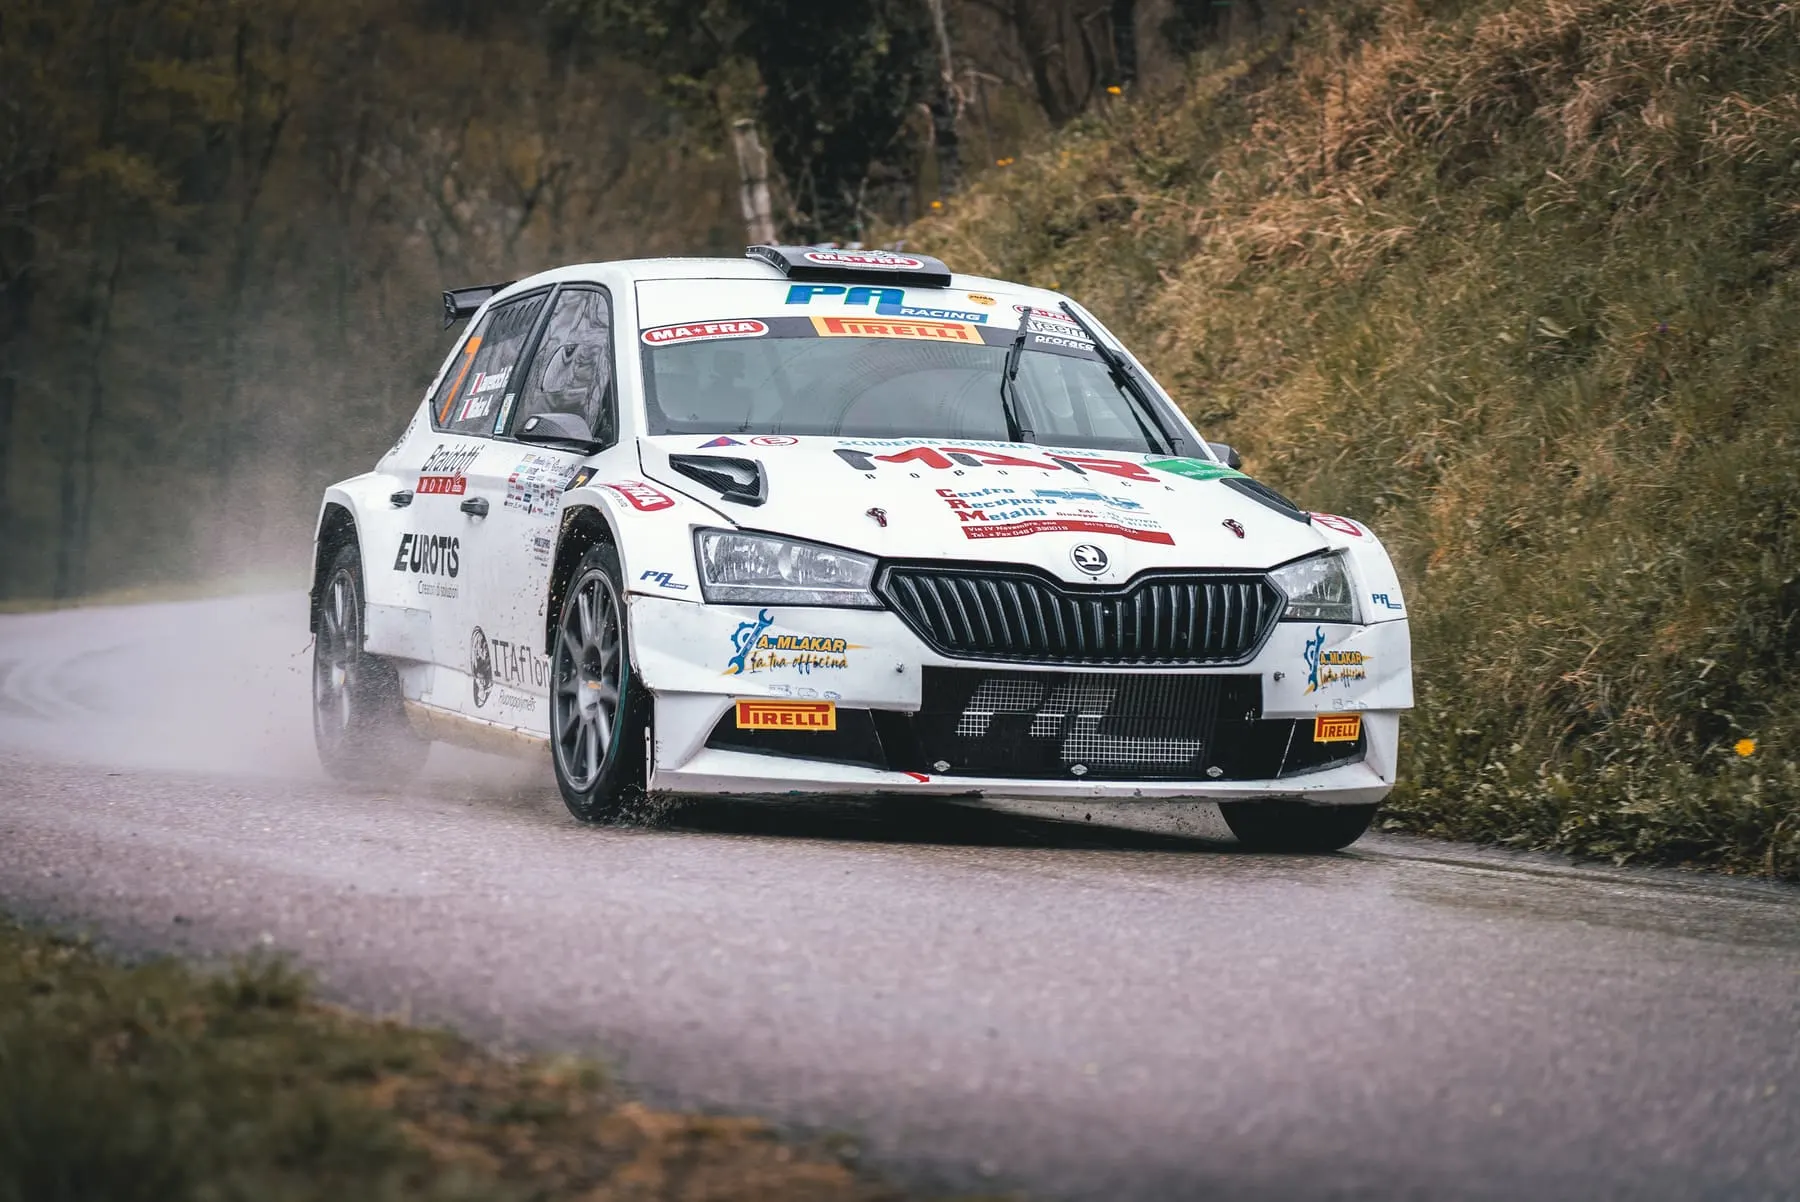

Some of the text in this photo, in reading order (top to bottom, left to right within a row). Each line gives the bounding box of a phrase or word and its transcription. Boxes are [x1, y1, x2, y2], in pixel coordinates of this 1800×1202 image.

[785, 284, 905, 316] PA
[900, 307, 981, 321] RACING
[823, 317, 969, 340] PIRELLI
[838, 439, 941, 448] SCUDERIA
[935, 487, 1015, 498] Centro
[944, 498, 1058, 509] Recupero
[954, 508, 1048, 522] Metalli
[757, 635, 847, 653] A. MLAKAR
[768, 652, 787, 671] tua
[792, 653, 848, 675] officina
[1330, 651, 1362, 666] MLAKAR
[740, 703, 831, 726] PIRELLI
[1317, 716, 1360, 738] PIRELLI
